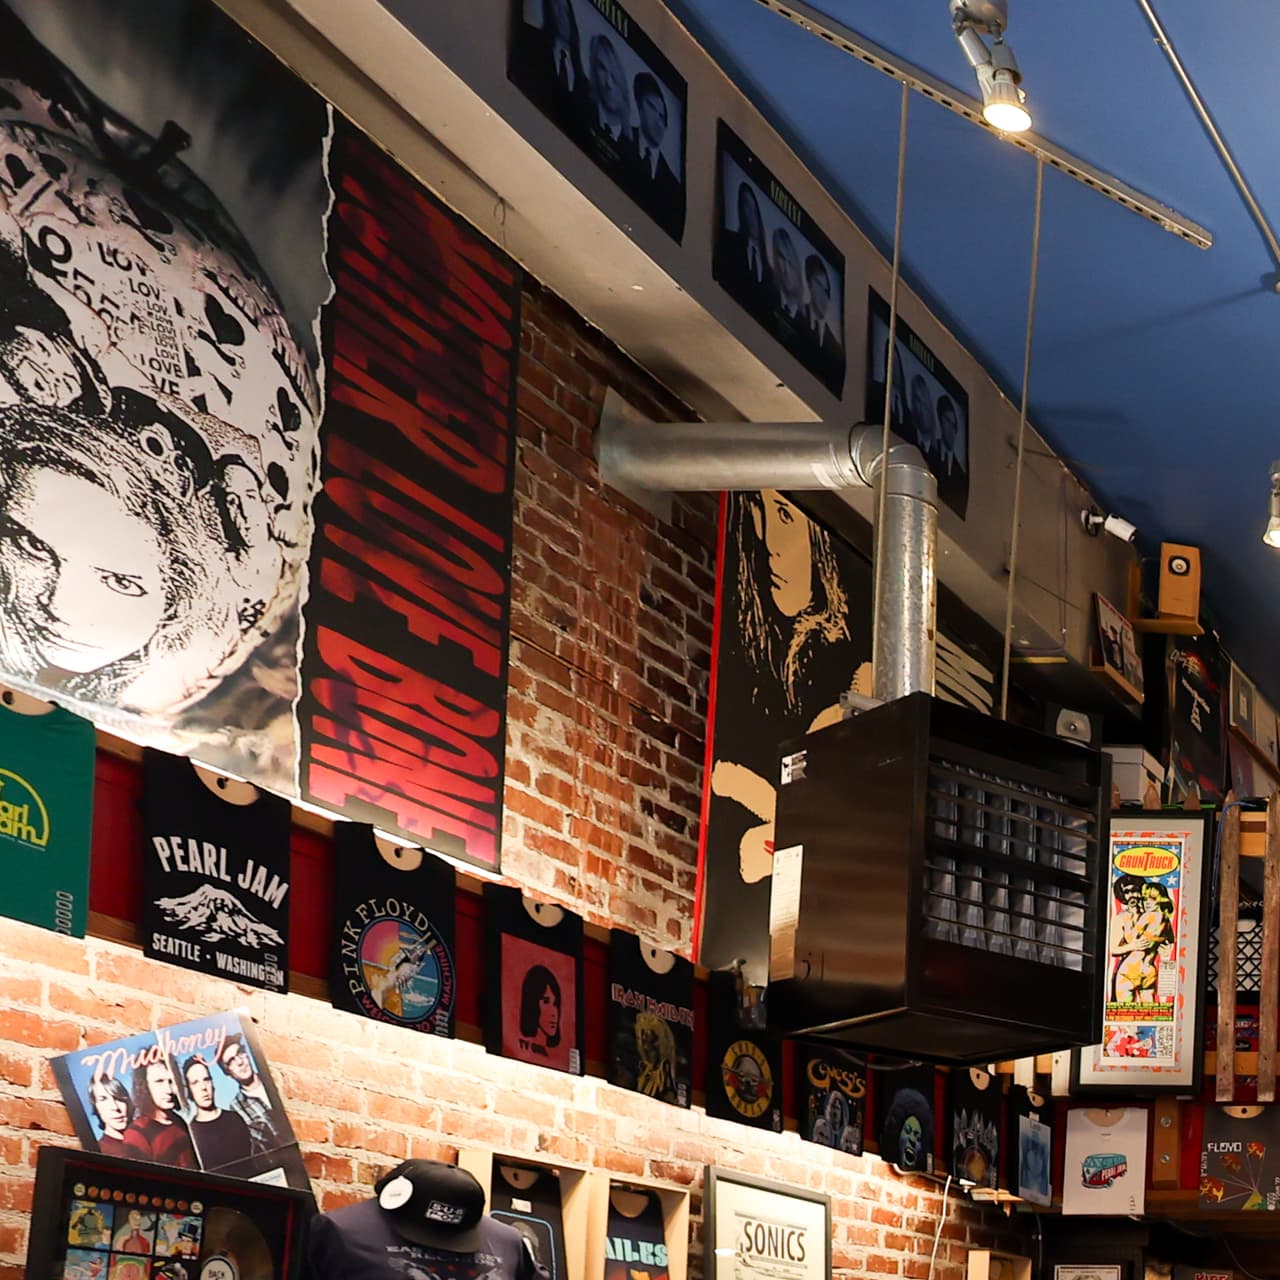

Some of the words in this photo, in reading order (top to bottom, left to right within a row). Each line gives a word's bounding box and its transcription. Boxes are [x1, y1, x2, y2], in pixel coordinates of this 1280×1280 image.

[318, 451, 505, 681] LOVE
[308, 622, 500, 871] BONE
[152, 835, 232, 882] PEARL
[237, 859, 289, 910] JAM
[341, 920, 367, 995] PINK
[354, 897, 428, 932] FLOYD
[81, 1024, 227, 1081] Mudhoney
[1207, 1142, 1242, 1153] FLOYD
[742, 1218, 807, 1263] SONICS
